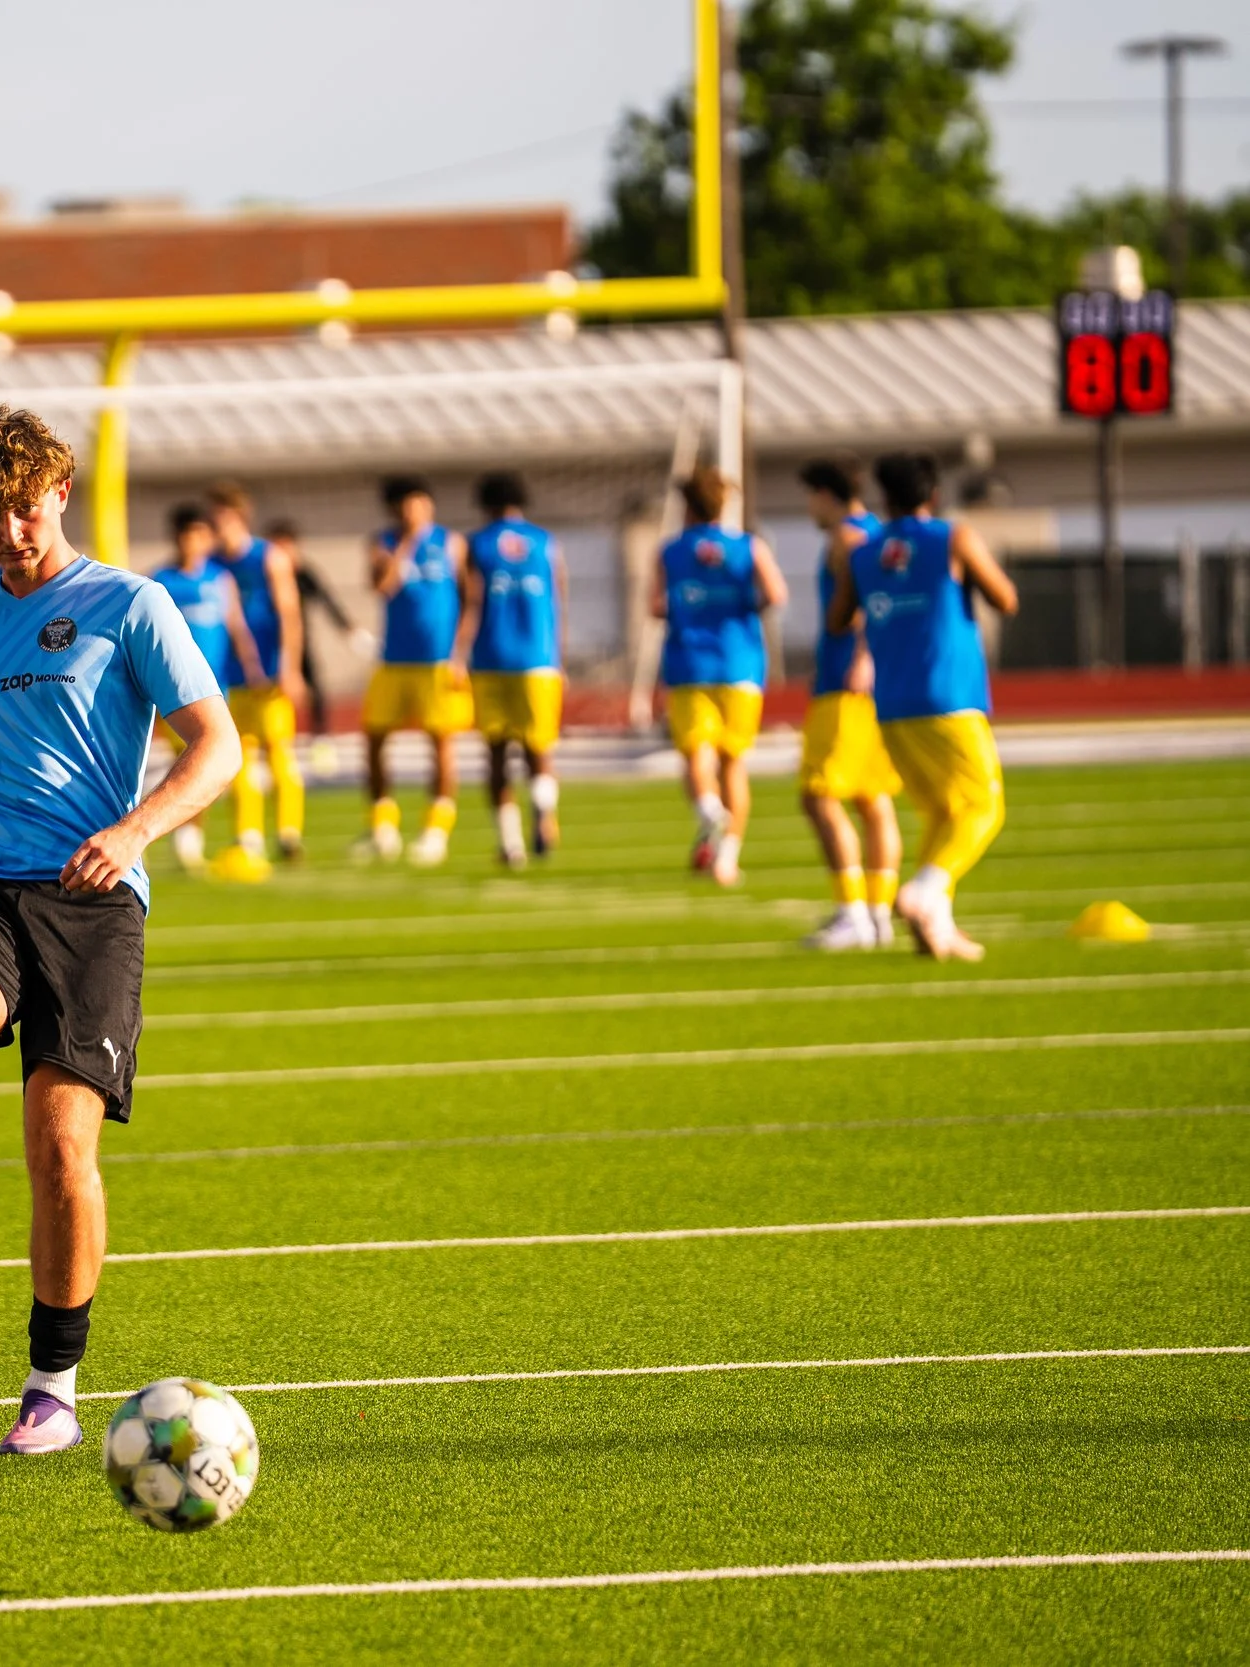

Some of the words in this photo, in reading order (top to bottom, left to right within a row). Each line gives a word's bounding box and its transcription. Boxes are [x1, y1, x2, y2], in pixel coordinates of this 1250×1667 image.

[1066, 332, 1171, 418] 80
[0, 672, 34, 692] zap
[35, 674, 76, 684] MOVING
